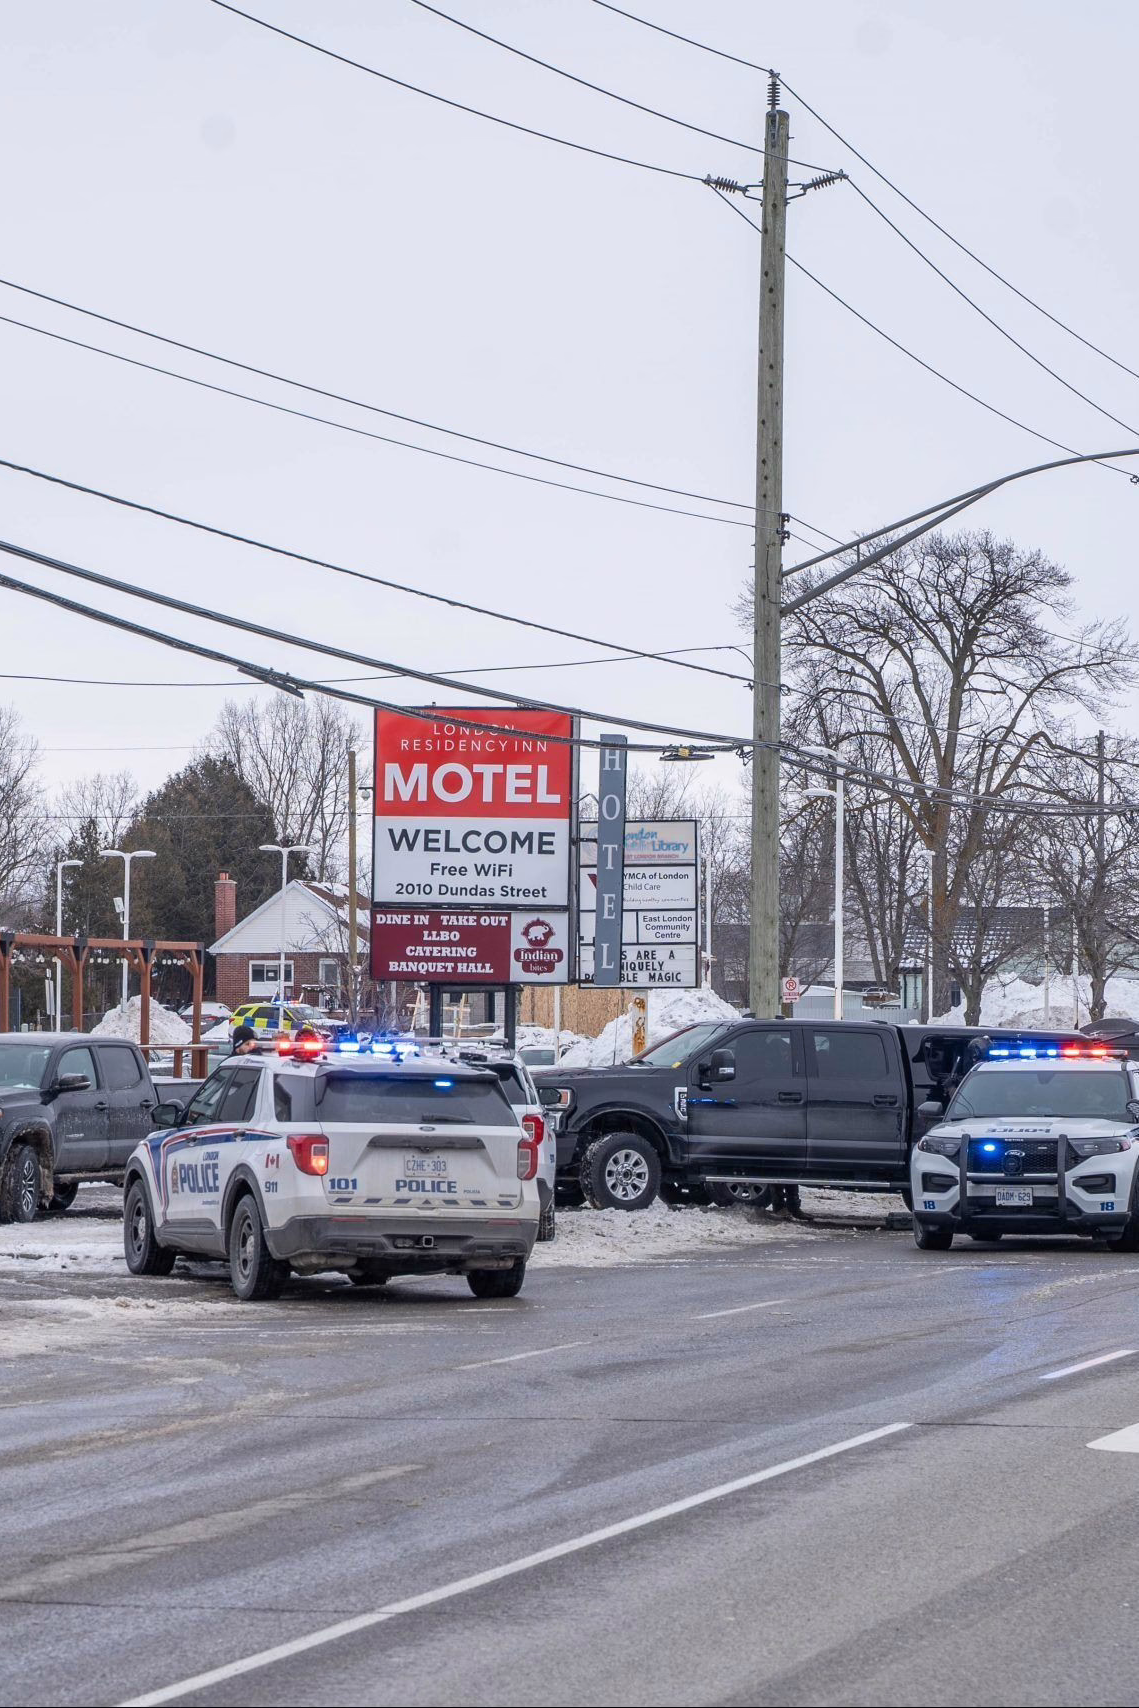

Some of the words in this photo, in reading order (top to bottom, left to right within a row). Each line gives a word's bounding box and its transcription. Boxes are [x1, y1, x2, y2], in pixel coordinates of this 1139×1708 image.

[401, 740, 508, 752] RESIDENCY
[514, 740, 548, 752] INN
[384, 762, 561, 804] MOTEL
[625, 828, 658, 840] ondon
[388, 828, 556, 855] WELCOME
[653, 840, 689, 854] Library
[601, 749, 622, 970] HOTEL
[430, 863, 468, 876] Free
[474, 864, 513, 877] WiFi
[648, 872, 658, 880] of
[658, 872, 689, 880] London
[395, 883, 432, 896] 2010
[438, 884, 495, 897] Dundas
[500, 886, 548, 898] Street
[376, 914, 411, 925] DINE
[414, 914, 430, 925] IN
[440, 915, 477, 926] TAKE
[480, 916, 508, 926] OUT
[644, 923, 690, 932] Community
[422, 930, 460, 942] LLBO
[405, 946, 477, 958] CATERING
[519, 948, 558, 963] Indian
[636, 950, 657, 960] ARE
[668, 950, 675, 960] A
[388, 961, 454, 974] BANQUET
[457, 962, 494, 974] HALL
[529, 963, 548, 972] bites
[648, 972, 682, 982] MAGIC
[178, 1163, 220, 1194] POLICE
[328, 1178, 358, 1190] 101
[264, 1181, 278, 1193] 911
[395, 1180, 458, 1194] POLICE
[923, 1200, 936, 1210] 18
[1100, 1202, 1114, 1212] 18
